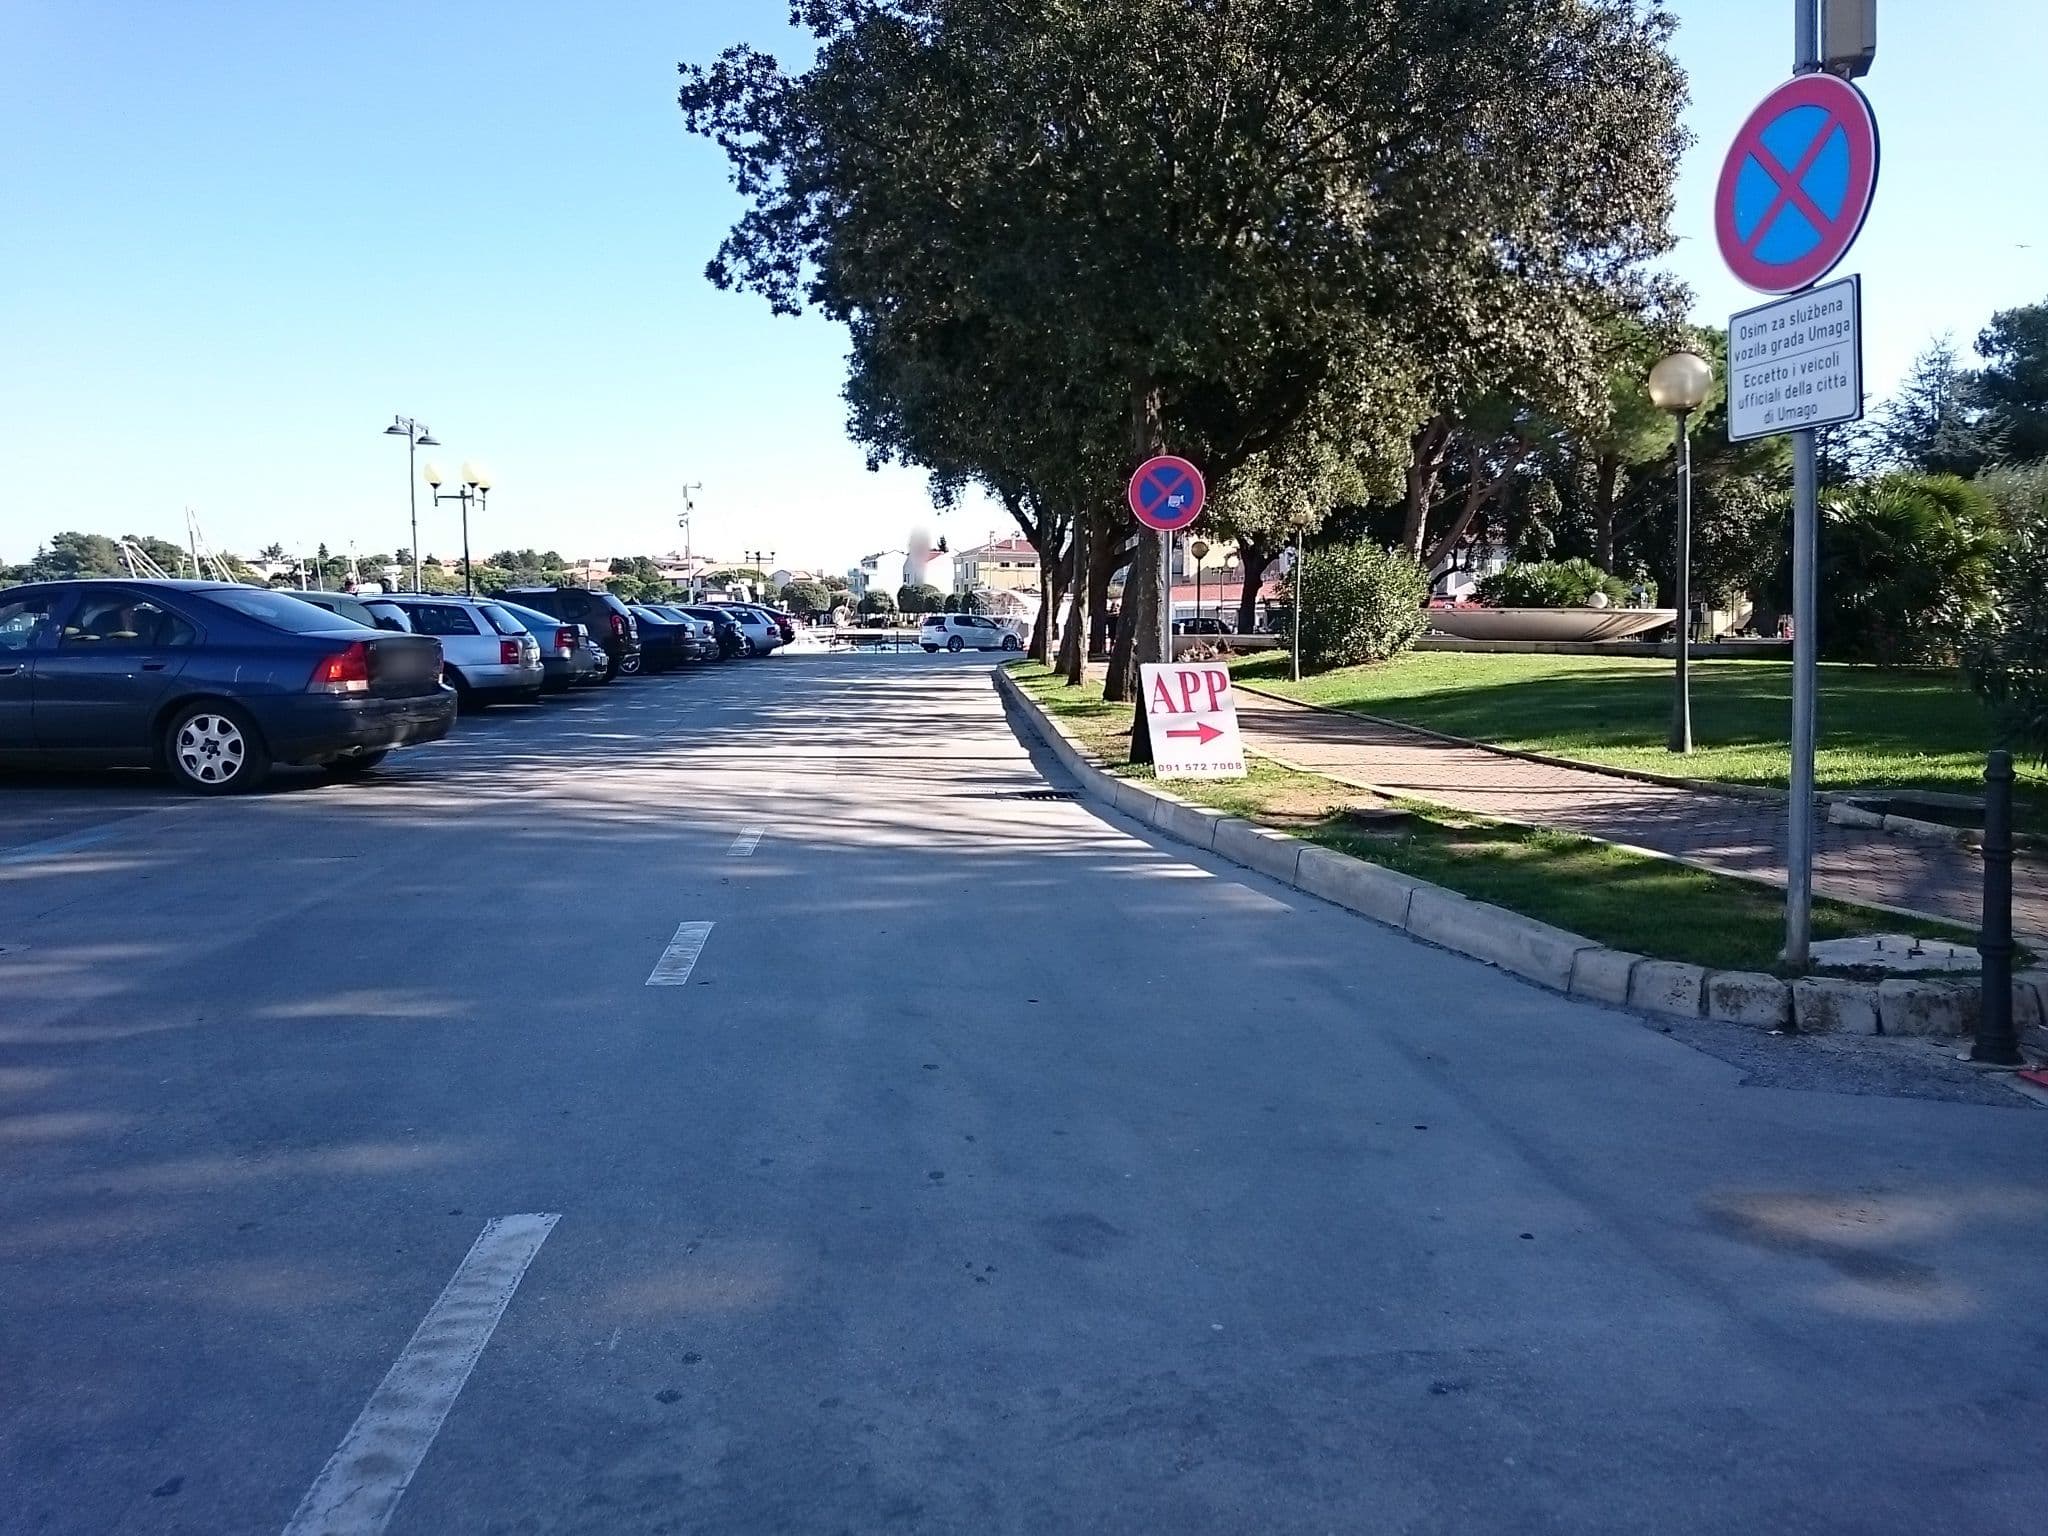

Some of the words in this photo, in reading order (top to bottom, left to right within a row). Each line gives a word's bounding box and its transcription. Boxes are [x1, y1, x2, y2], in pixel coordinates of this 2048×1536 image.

[1734, 344, 1767, 362] vozila
[1770, 333, 1804, 356] grada
[1808, 319, 1850, 342] Umaga
[1740, 323, 1767, 340] Osim
[1772, 320, 1785, 331] za
[1744, 366, 1788, 388] Eccetto
[1800, 351, 1840, 374] veicoli
[1738, 388, 1781, 409] ufficiali
[1785, 381, 1812, 399] della
[1763, 411, 1774, 424] di
[1778, 403, 1818, 421] Umago
[1149, 670, 1227, 714] APP
[1158, 764, 1180, 772] 091
